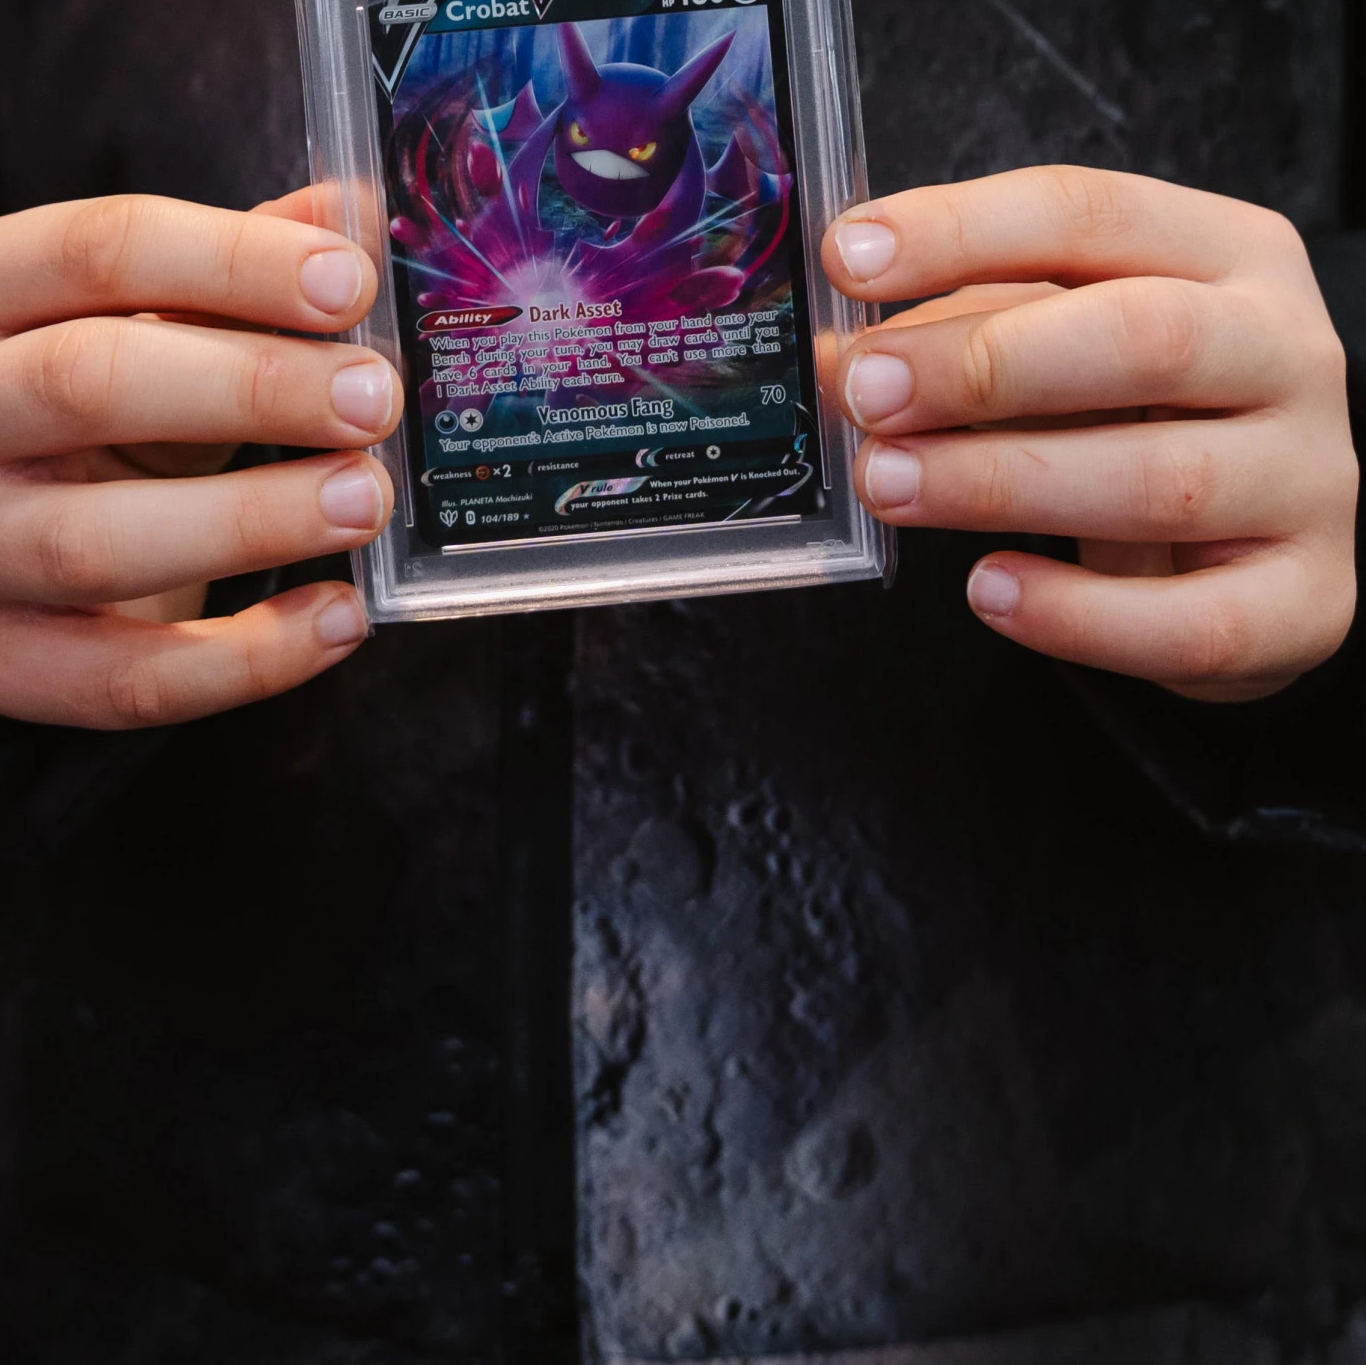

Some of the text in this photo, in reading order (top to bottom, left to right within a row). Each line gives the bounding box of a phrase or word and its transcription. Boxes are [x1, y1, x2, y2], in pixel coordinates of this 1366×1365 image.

[384, 7, 430, 20] BASIC
[434, 313, 492, 326] Ability
[529, 300, 623, 323] Dark Asset
[429, 310, 778, 351] When you play this Pokémon from your hand onto your
[431, 326, 780, 367] Bench during your turn, you may draw cards until you
[432, 340, 781, 383] have 6 cards in your hand. You can't use more than
[447, 383, 480, 398] Dark
[481, 379, 518, 395] Asset
[519, 375, 559, 392] Ability
[562, 372, 591, 386] each
[592, 371, 625, 385] turn.
[536, 384, 786, 425] Venomous Fang 70
[439, 412, 751, 453] Your opponent's Active Pokémon is now Poisoned.
[665, 450, 695, 460] retreat
[433, 470, 472, 481] weakness
[537, 461, 579, 472] resistance
[649, 478, 672, 488] When
[674, 478, 692, 488] your
[693, 474, 729, 485] Pokémon
[730, 473, 739, 482] V
[740, 472, 747, 480] is
[748, 469, 782, 479] Knocked
[460, 496, 494, 506] PLANETA
[495, 492, 533, 503] Mochizuki
[571, 501, 588, 511] your
[591, 497, 629, 509] opponent
[631, 495, 653, 504] takes
[663, 492, 683, 501] Prize
[685, 490, 709, 499] cards.
[481, 512, 519, 524] 104/189
